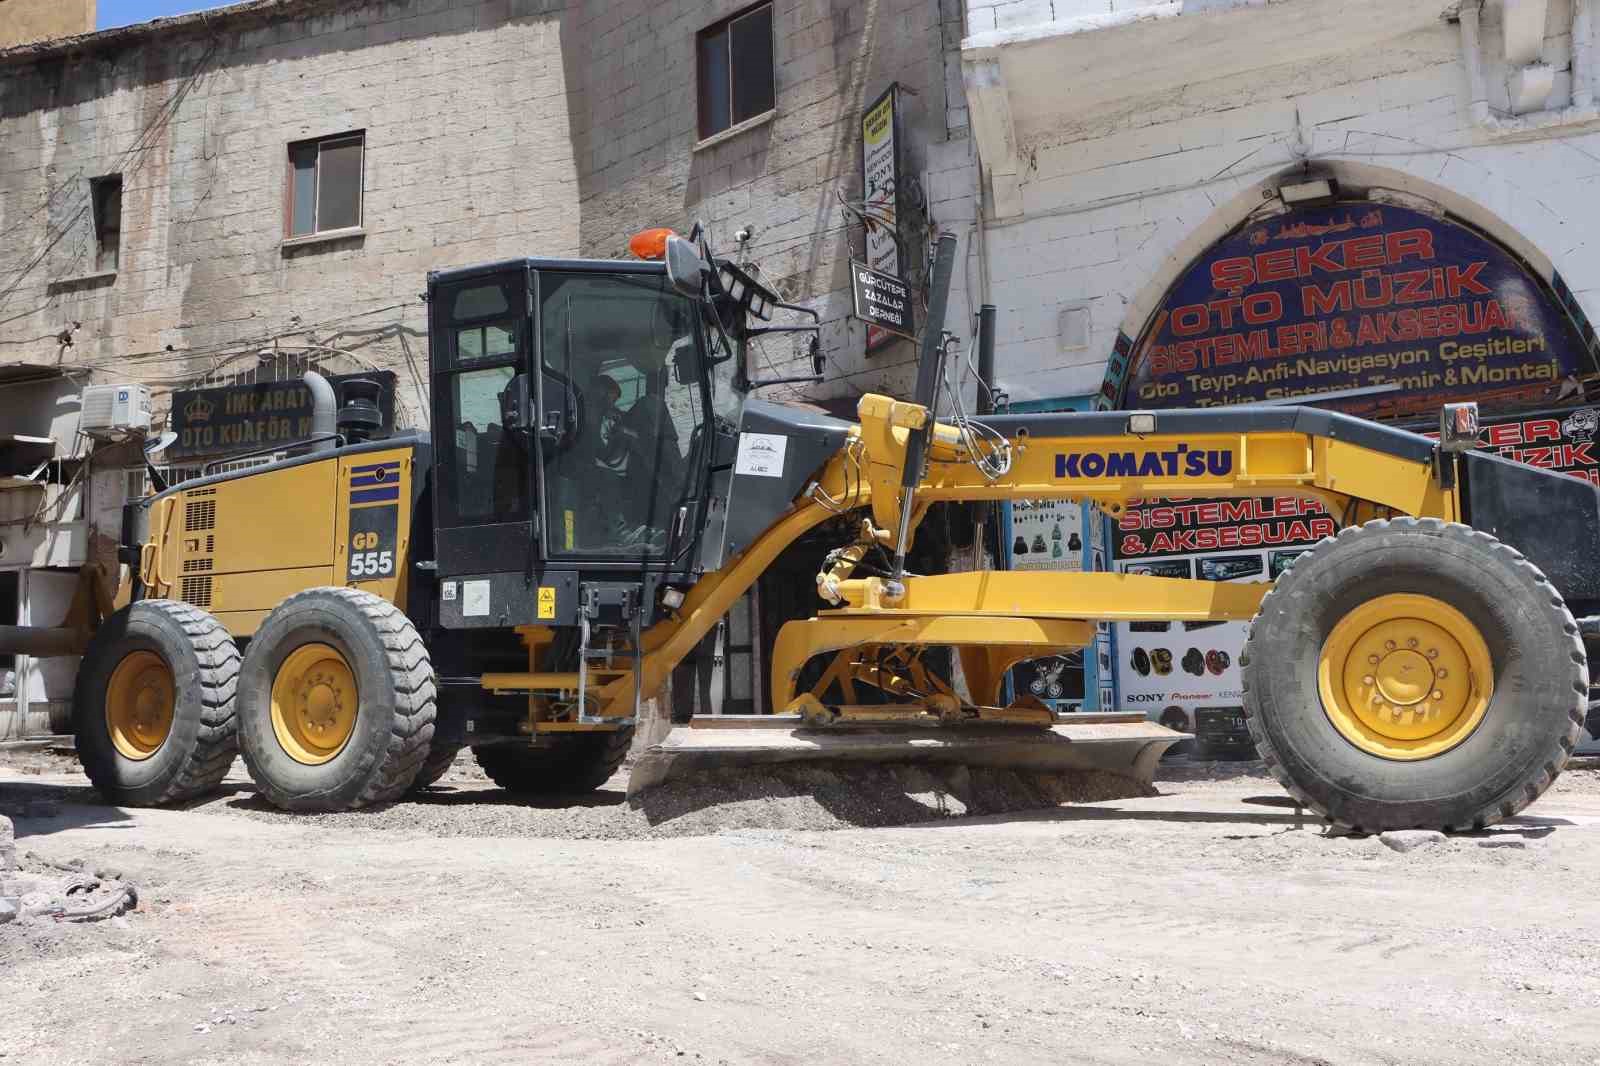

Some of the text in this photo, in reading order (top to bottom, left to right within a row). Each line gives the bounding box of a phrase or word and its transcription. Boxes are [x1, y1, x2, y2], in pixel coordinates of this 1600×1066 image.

[1211, 228, 1436, 296] ŞEKER
[864, 289, 904, 311] ZAZALAR
[1170, 291, 1283, 336] OTO
[1328, 316, 1354, 349] &
[1140, 382, 1180, 399] Oto
[1439, 335, 1546, 366] Çeşitleri
[1443, 368, 1459, 386] &
[1461, 358, 1560, 384] Montaj
[1055, 443, 1232, 478] KOMATSU
[1119, 496, 1328, 530] SiSTEMLER
[353, 531, 379, 550] GD
[1121, 518, 1335, 555] & AKSESUAR
[350, 550, 393, 576] 555
[1126, 692, 1165, 703] SONY
[1170, 691, 1213, 701] Pioneer
